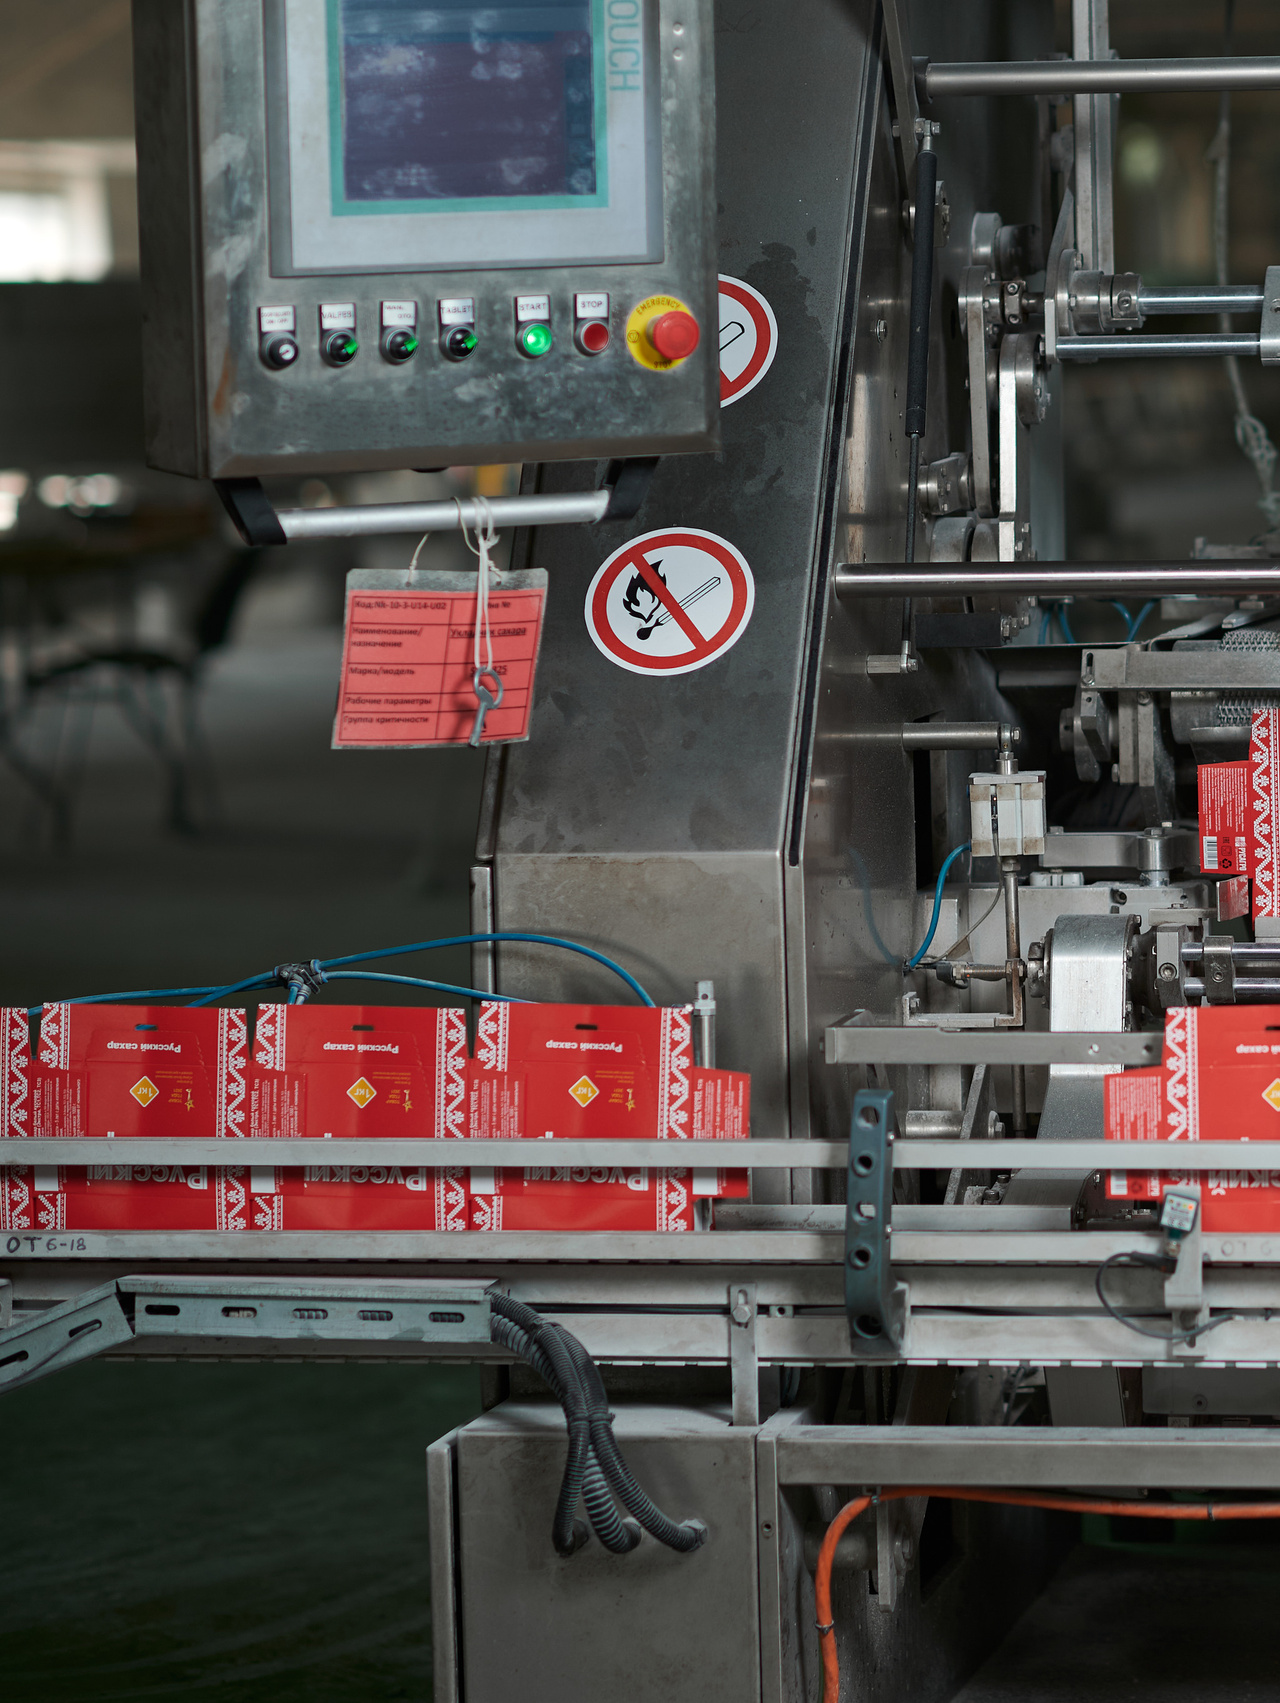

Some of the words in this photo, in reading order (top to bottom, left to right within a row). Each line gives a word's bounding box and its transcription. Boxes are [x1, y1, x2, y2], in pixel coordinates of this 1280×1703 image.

[519, 302, 547, 311] START
[581, 300, 603, 309] STOP
[636, 297, 681, 315] EMERGENCY
[1239, 847, 1247, 871] РУСАГРО
[107, 1041, 138, 1050] сахар
[140, 1043, 181, 1053] Русский
[323, 1042, 355, 1051] сахар
[357, 1043, 399, 1054] Русский
[545, 1040, 578, 1049] сахар
[580, 1042, 623, 1053] Русский
[46, 1237, 87, 1251] 6-18
